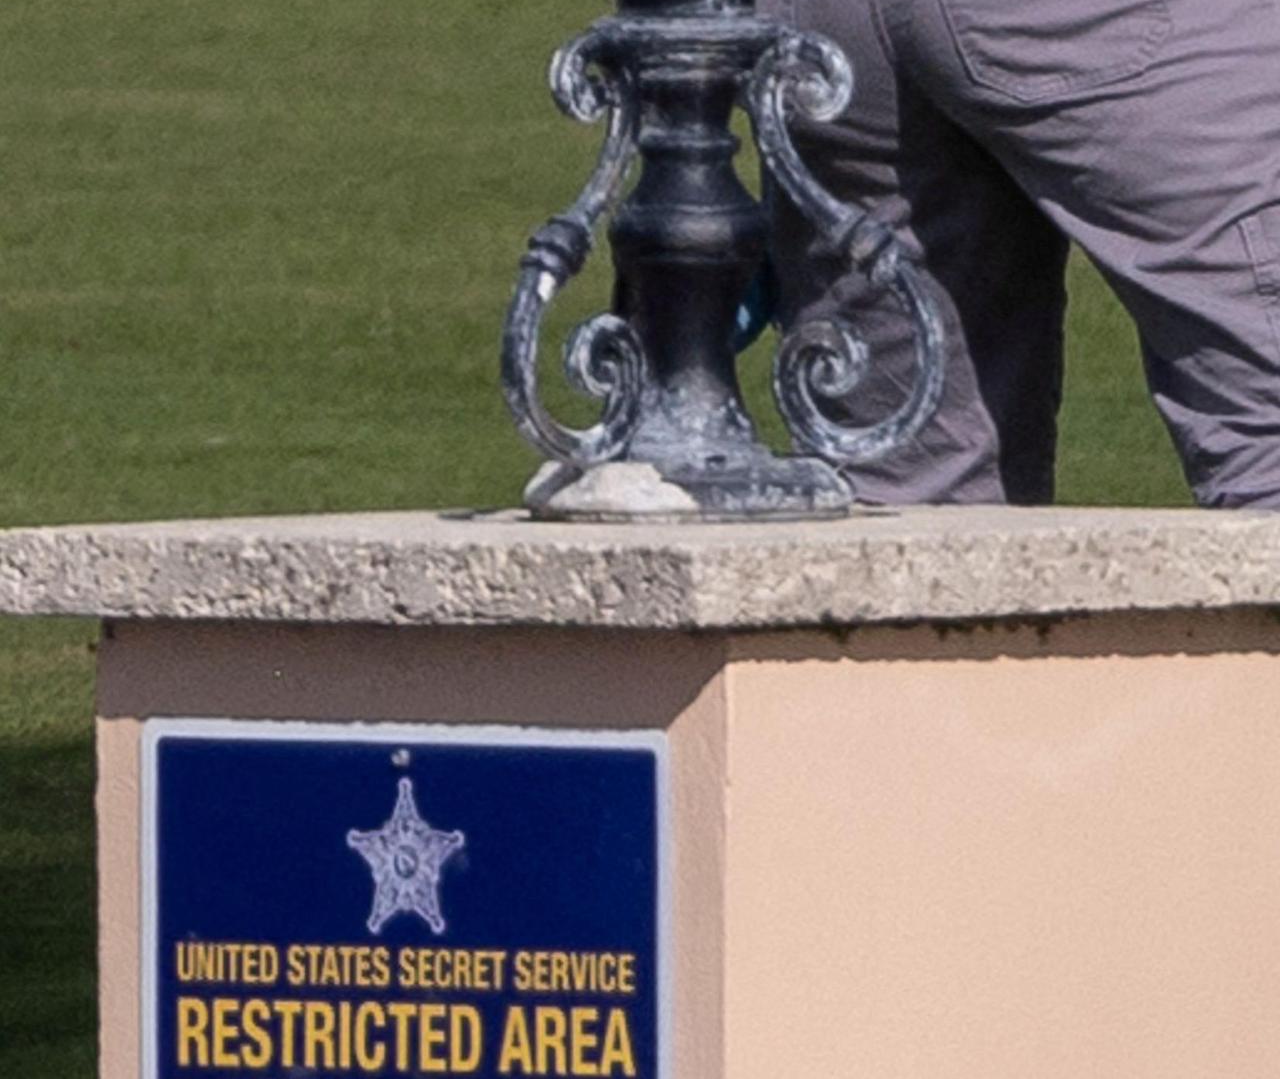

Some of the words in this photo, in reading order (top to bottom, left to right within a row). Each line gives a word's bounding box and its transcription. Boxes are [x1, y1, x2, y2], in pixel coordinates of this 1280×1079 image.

[176, 942, 279, 984] UNITED
[286, 944, 390, 987] STATES
[399, 948, 506, 990] SECRET
[513, 951, 636, 993] SERVICE
[177, 997, 483, 1073] RESTRICTED
[500, 1005, 637, 1077] AREA
